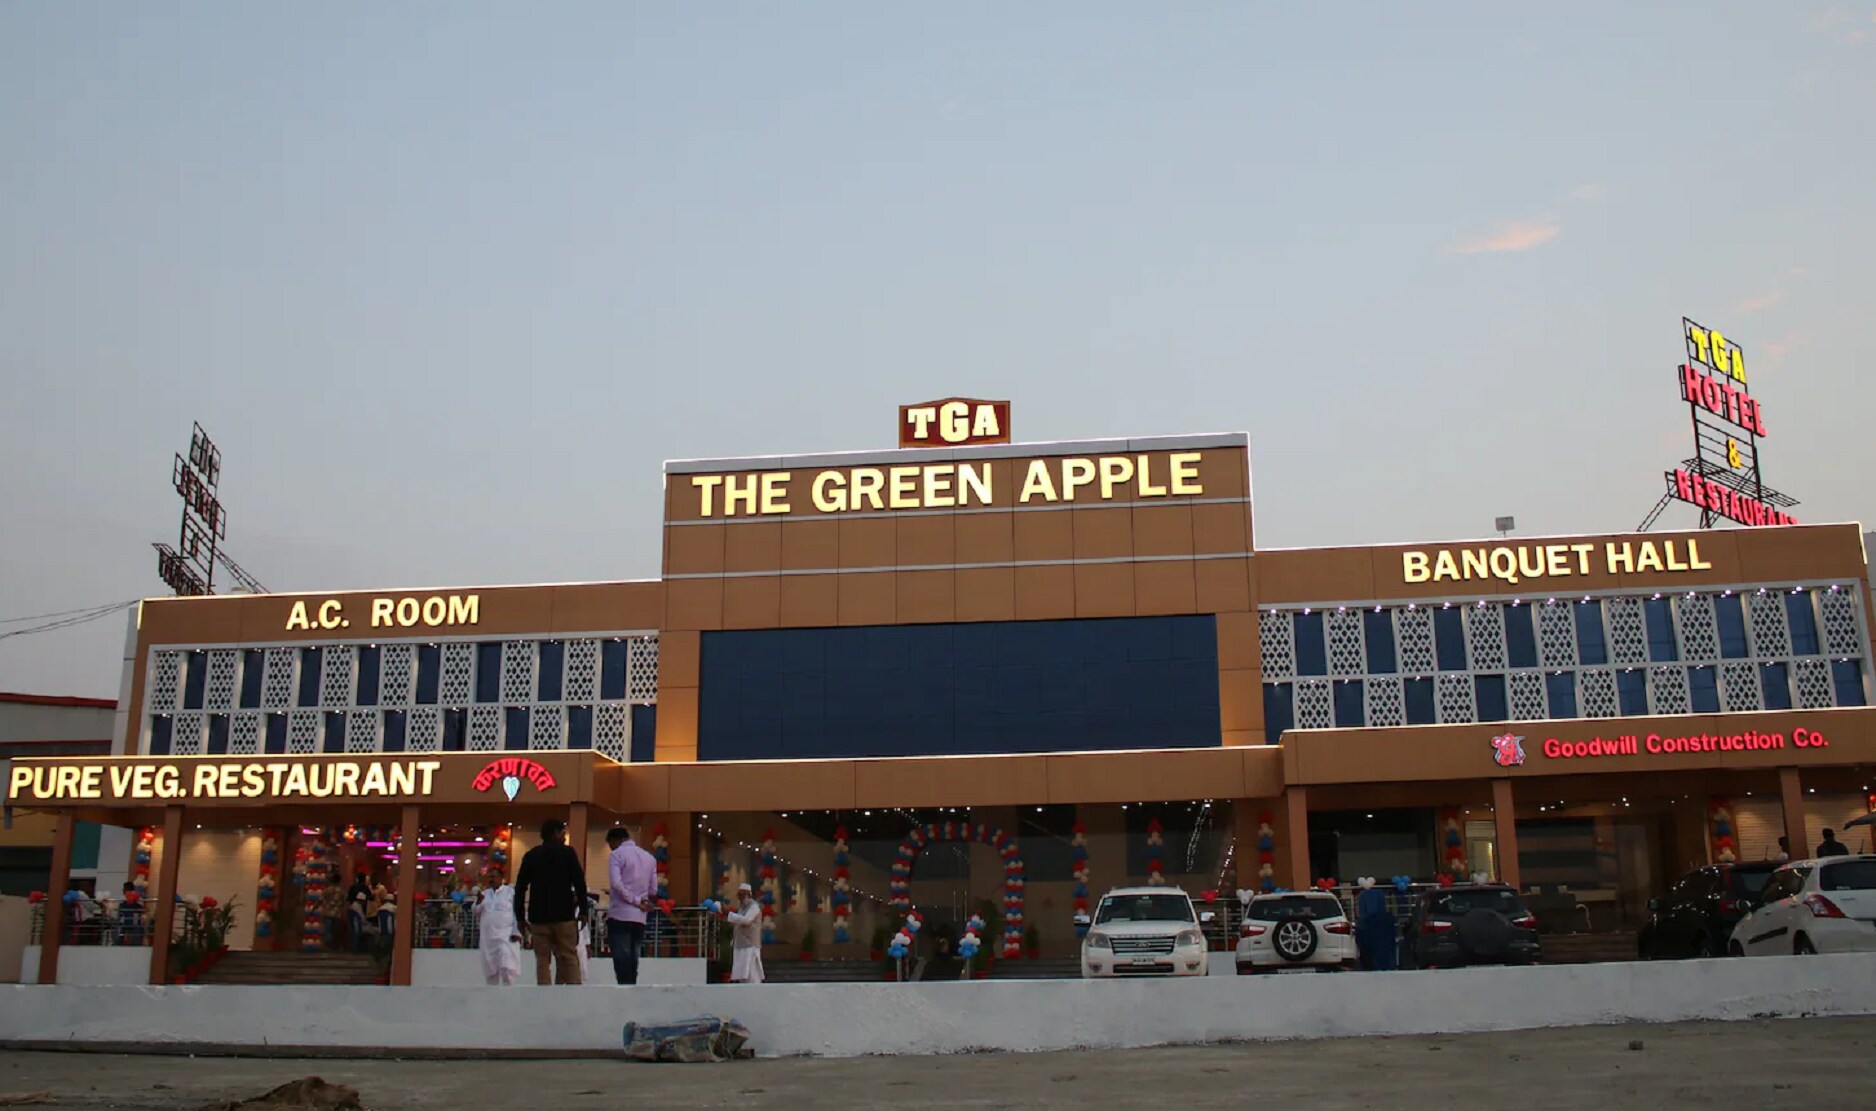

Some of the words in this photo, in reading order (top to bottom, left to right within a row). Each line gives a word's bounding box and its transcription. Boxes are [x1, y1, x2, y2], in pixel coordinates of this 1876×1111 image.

[1690, 327, 1747, 383] TGA
[1683, 365, 1767, 437] HOTEL
[906, 402, 1000, 442] TGA
[1727, 438, 1743, 469] &
[691, 472, 791, 517] THE
[811, 463, 992, 512] GREEN
[1019, 452, 1203, 503] APPLE
[1402, 544, 1595, 584] BANQUET
[1606, 538, 1712, 575] HALL
[285, 601, 349, 631] A.C.
[370, 594, 480, 629] ROOM
[1543, 735, 1638, 758] Goodwill
[1645, 730, 1785, 754] Construction
[1792, 727, 1830, 748] Co.
[9, 765, 103, 799] PURE
[109, 765, 186, 798] VEG.
[193, 761, 441, 798] RESTAURANT
